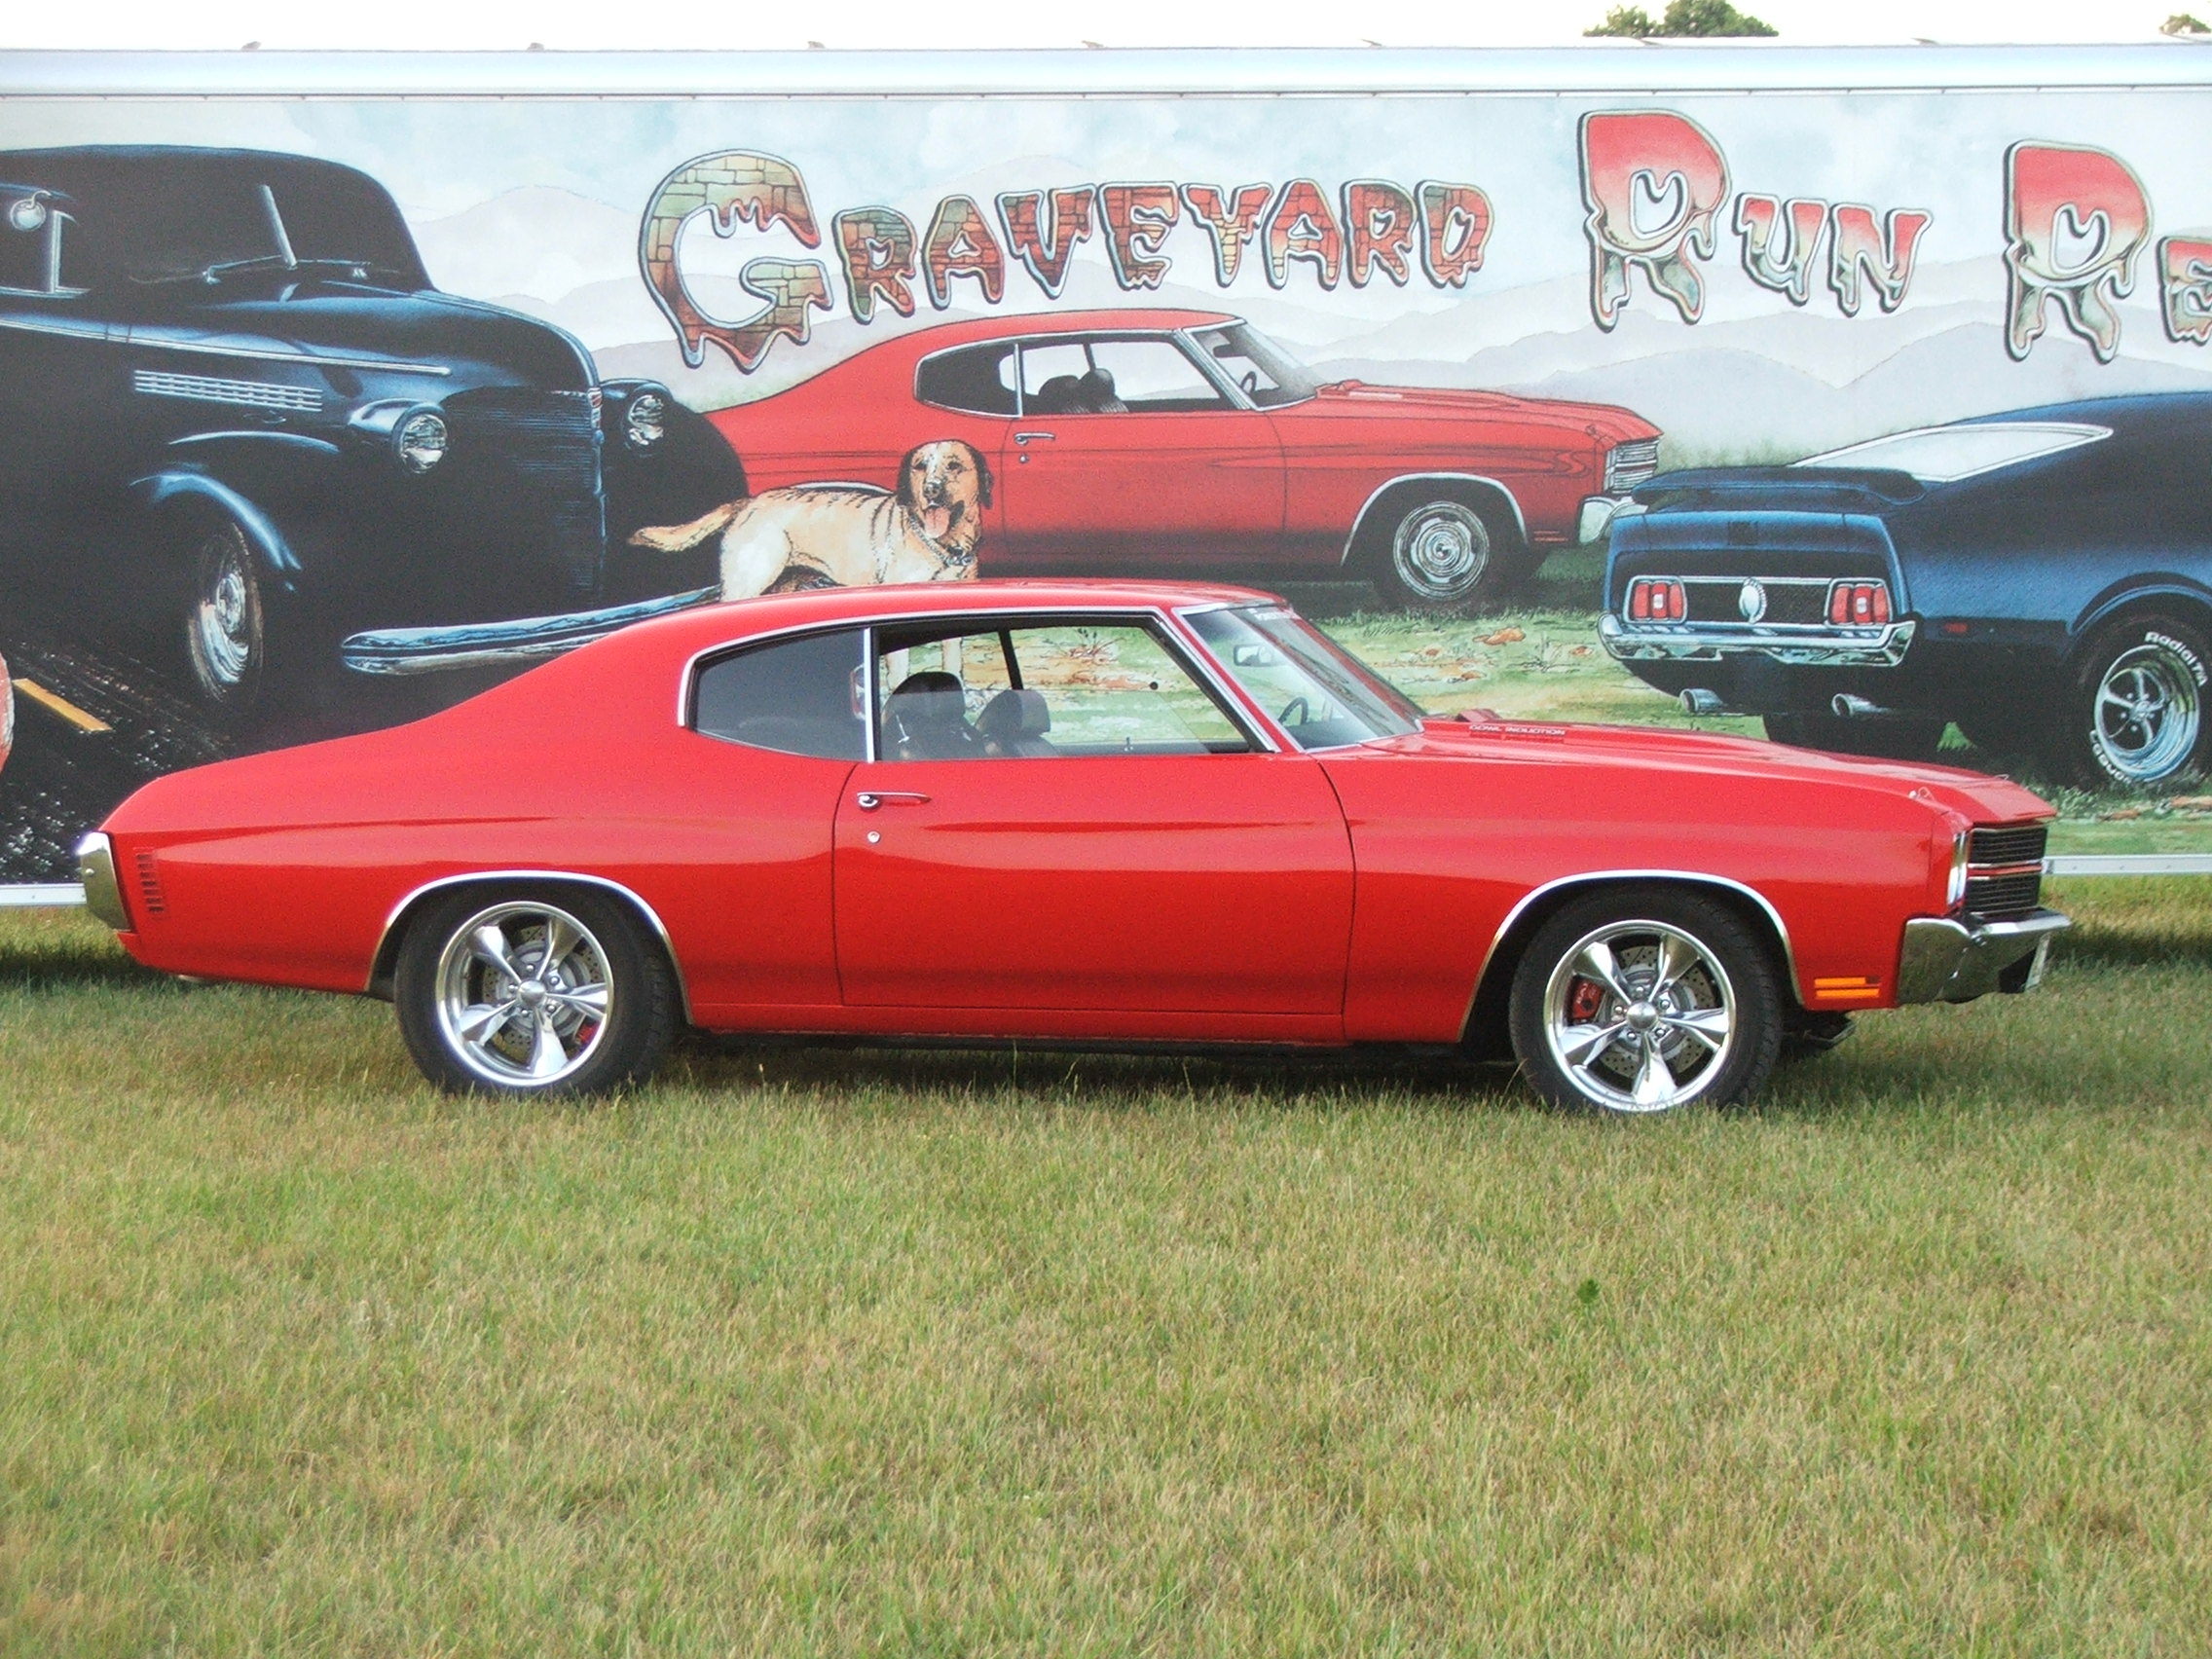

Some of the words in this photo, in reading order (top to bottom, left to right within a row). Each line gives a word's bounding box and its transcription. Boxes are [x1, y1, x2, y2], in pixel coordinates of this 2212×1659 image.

[638, 148, 1493, 375] GRAVEYARD
[1577, 108, 1932, 333] RUN
[1505, 726, 1565, 735] INDUCTION
